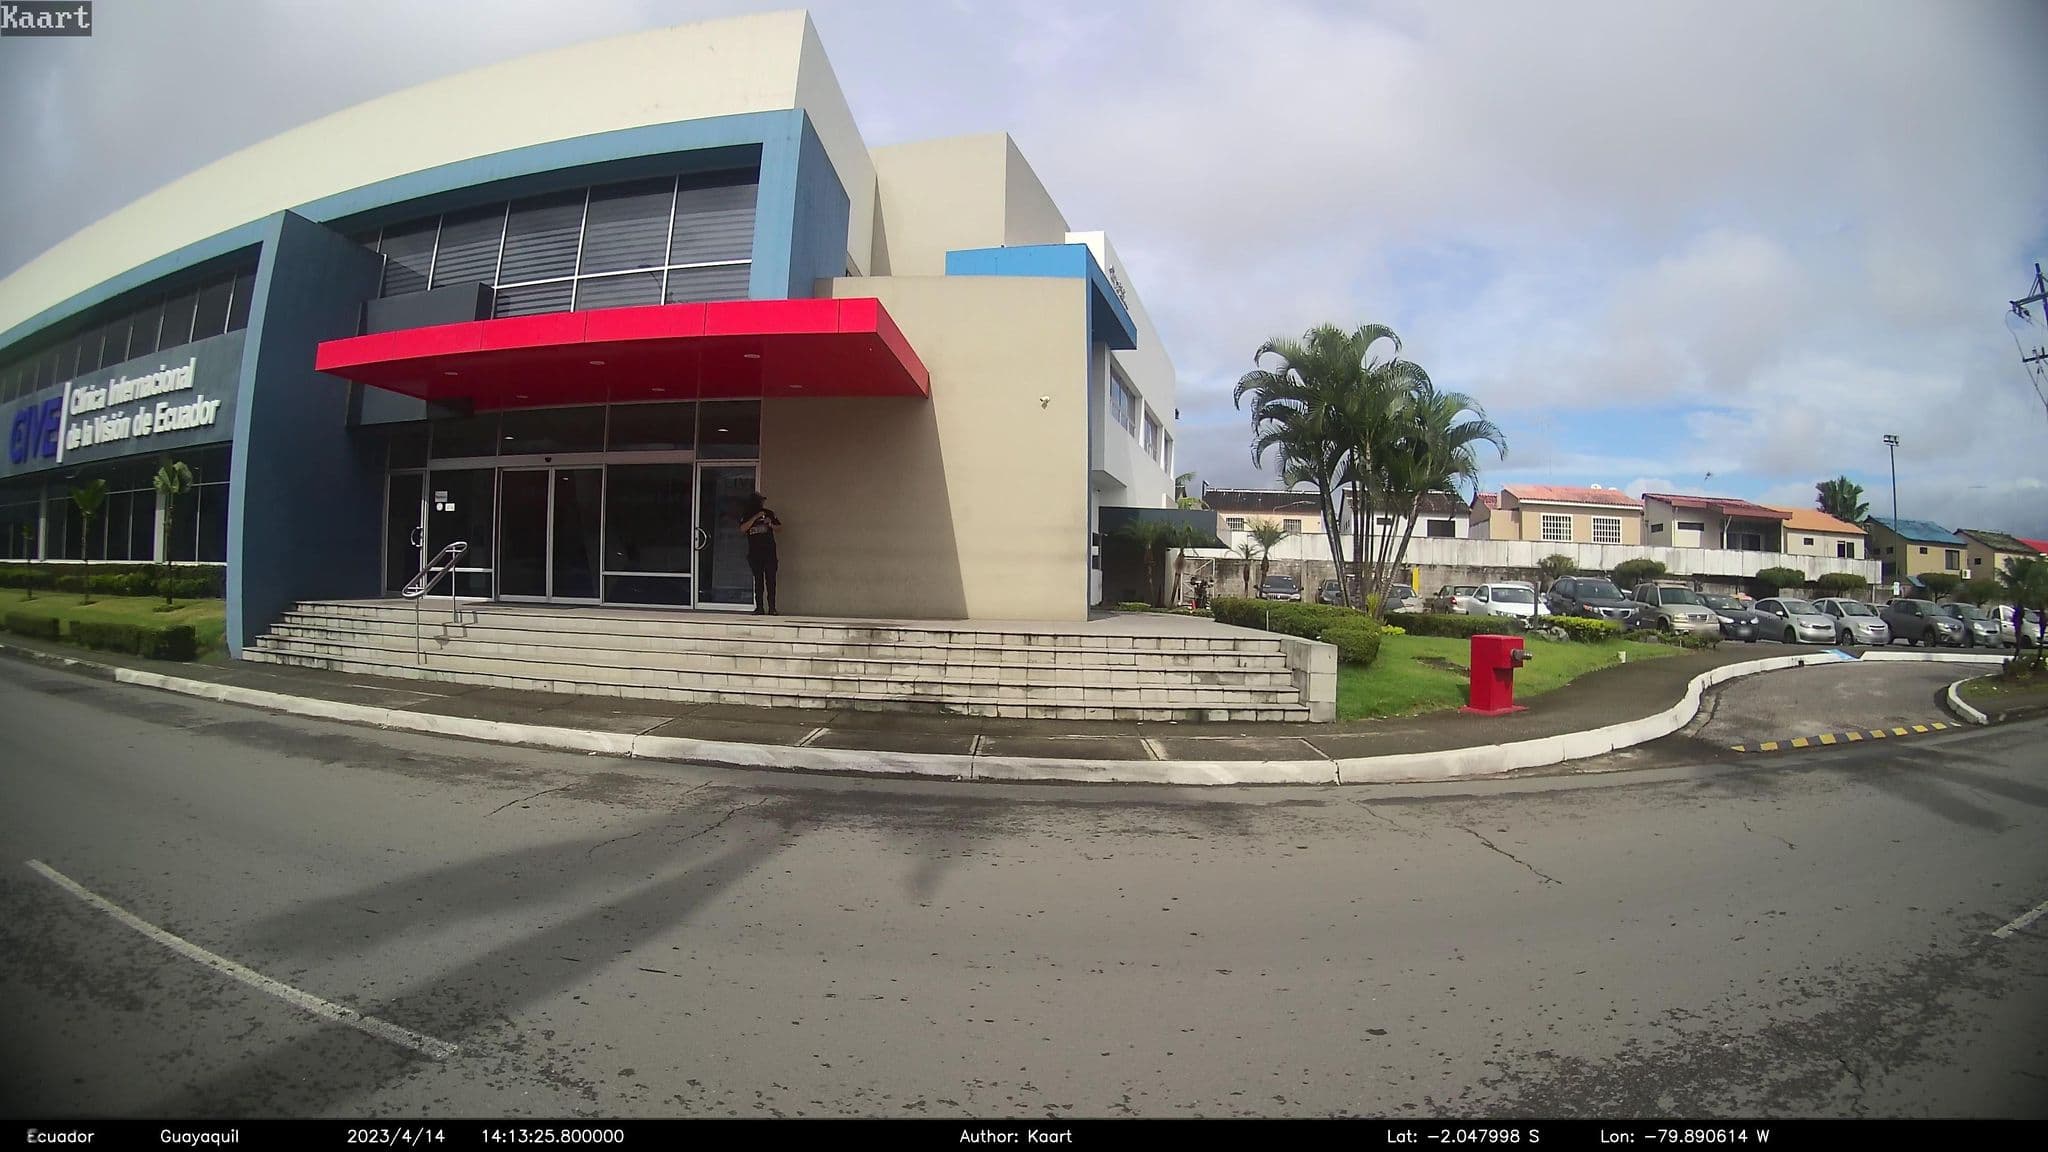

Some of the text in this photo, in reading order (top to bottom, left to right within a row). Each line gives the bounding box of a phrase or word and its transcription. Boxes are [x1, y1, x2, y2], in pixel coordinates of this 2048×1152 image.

[107, 357, 197, 406] Internacional
[66, 423, 81, 450] de
[81, 420, 94, 447] la
[132, 406, 153, 437] de
[153, 394, 221, 433] Ecuador
